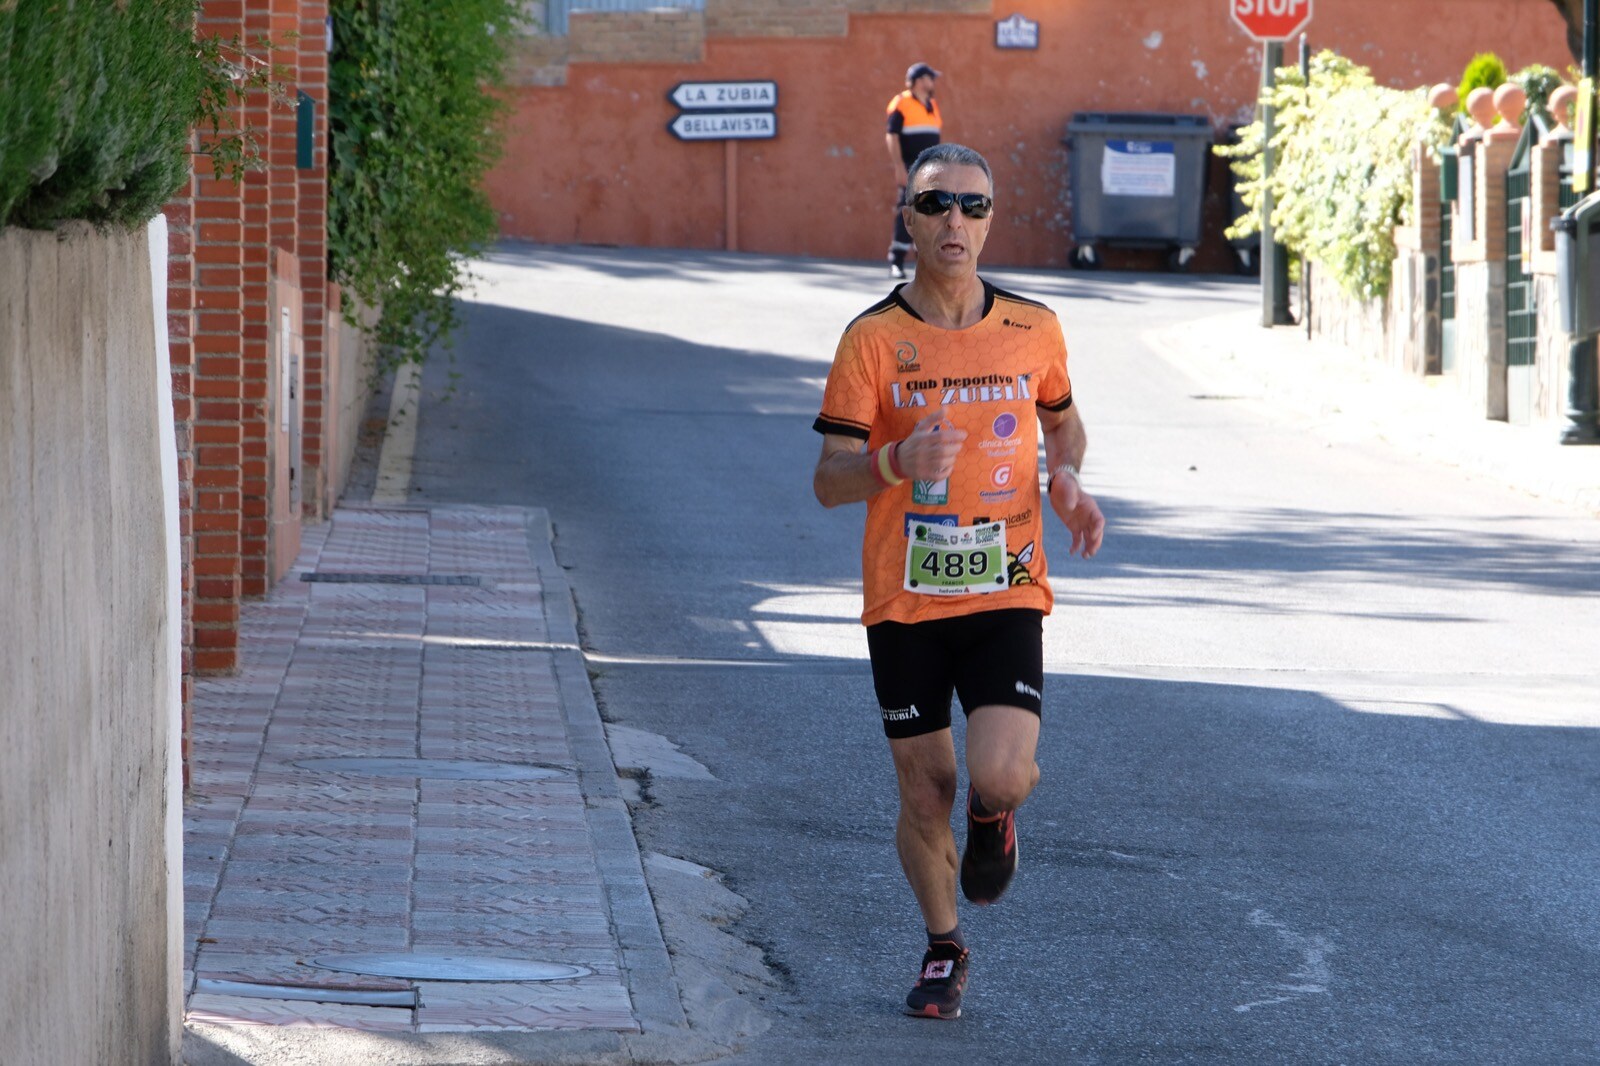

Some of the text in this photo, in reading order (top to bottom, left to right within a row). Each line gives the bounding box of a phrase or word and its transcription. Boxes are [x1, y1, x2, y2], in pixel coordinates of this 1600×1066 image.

[685, 86, 770, 101] LA ZUBIA
[683, 117, 769, 132] BELLAVISTA
[890, 373, 1031, 408] LA ZUBIA
[906, 374, 1013, 391] Club Deportivo
[920, 551, 988, 578] 489
[889, 704, 920, 721] ZUBIA
